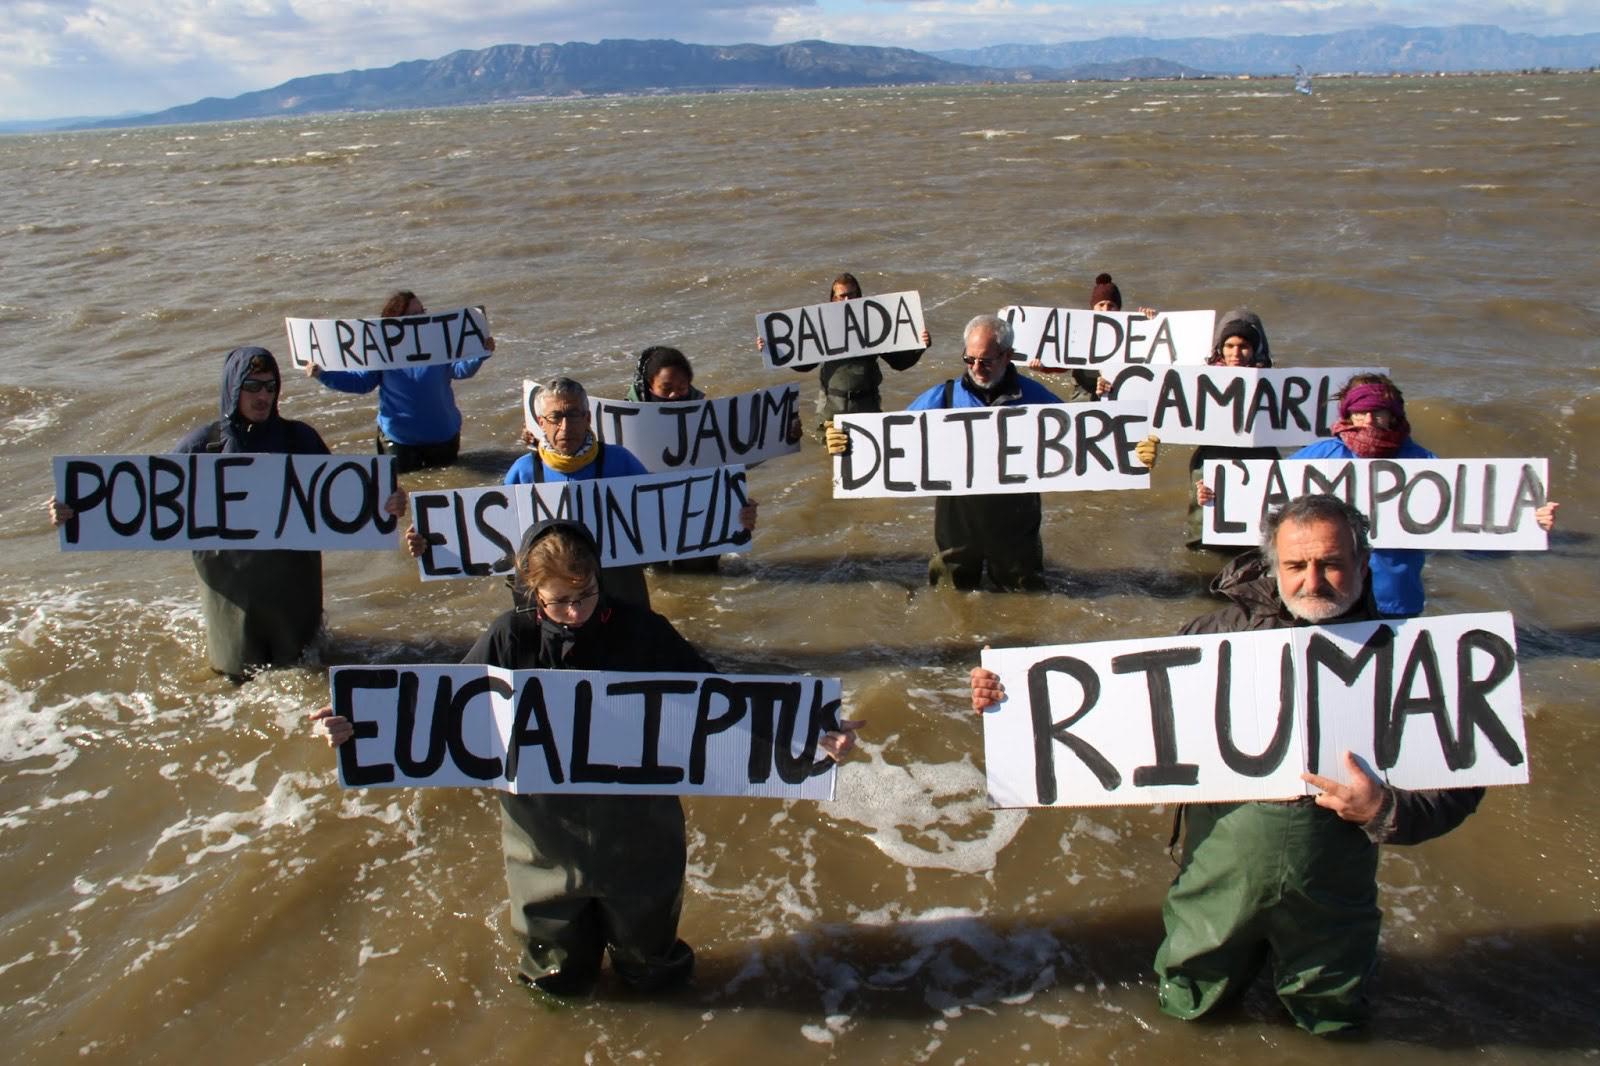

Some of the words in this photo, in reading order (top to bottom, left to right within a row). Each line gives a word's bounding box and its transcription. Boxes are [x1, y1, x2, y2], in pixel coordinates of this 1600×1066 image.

[289, 321, 326, 367] LA
[764, 296, 919, 366] BALADA
[658, 386, 799, 467] JAUME
[1110, 365, 1332, 438] CAMARL
[841, 407, 1150, 491] DELTEBRE
[65, 456, 258, 543] POBLE
[275, 454, 398, 538] NOU
[415, 491, 516, 576] ELS
[1213, 459, 1546, 540] L'AMPOLLA
[1028, 623, 1523, 805] RIUMAR
